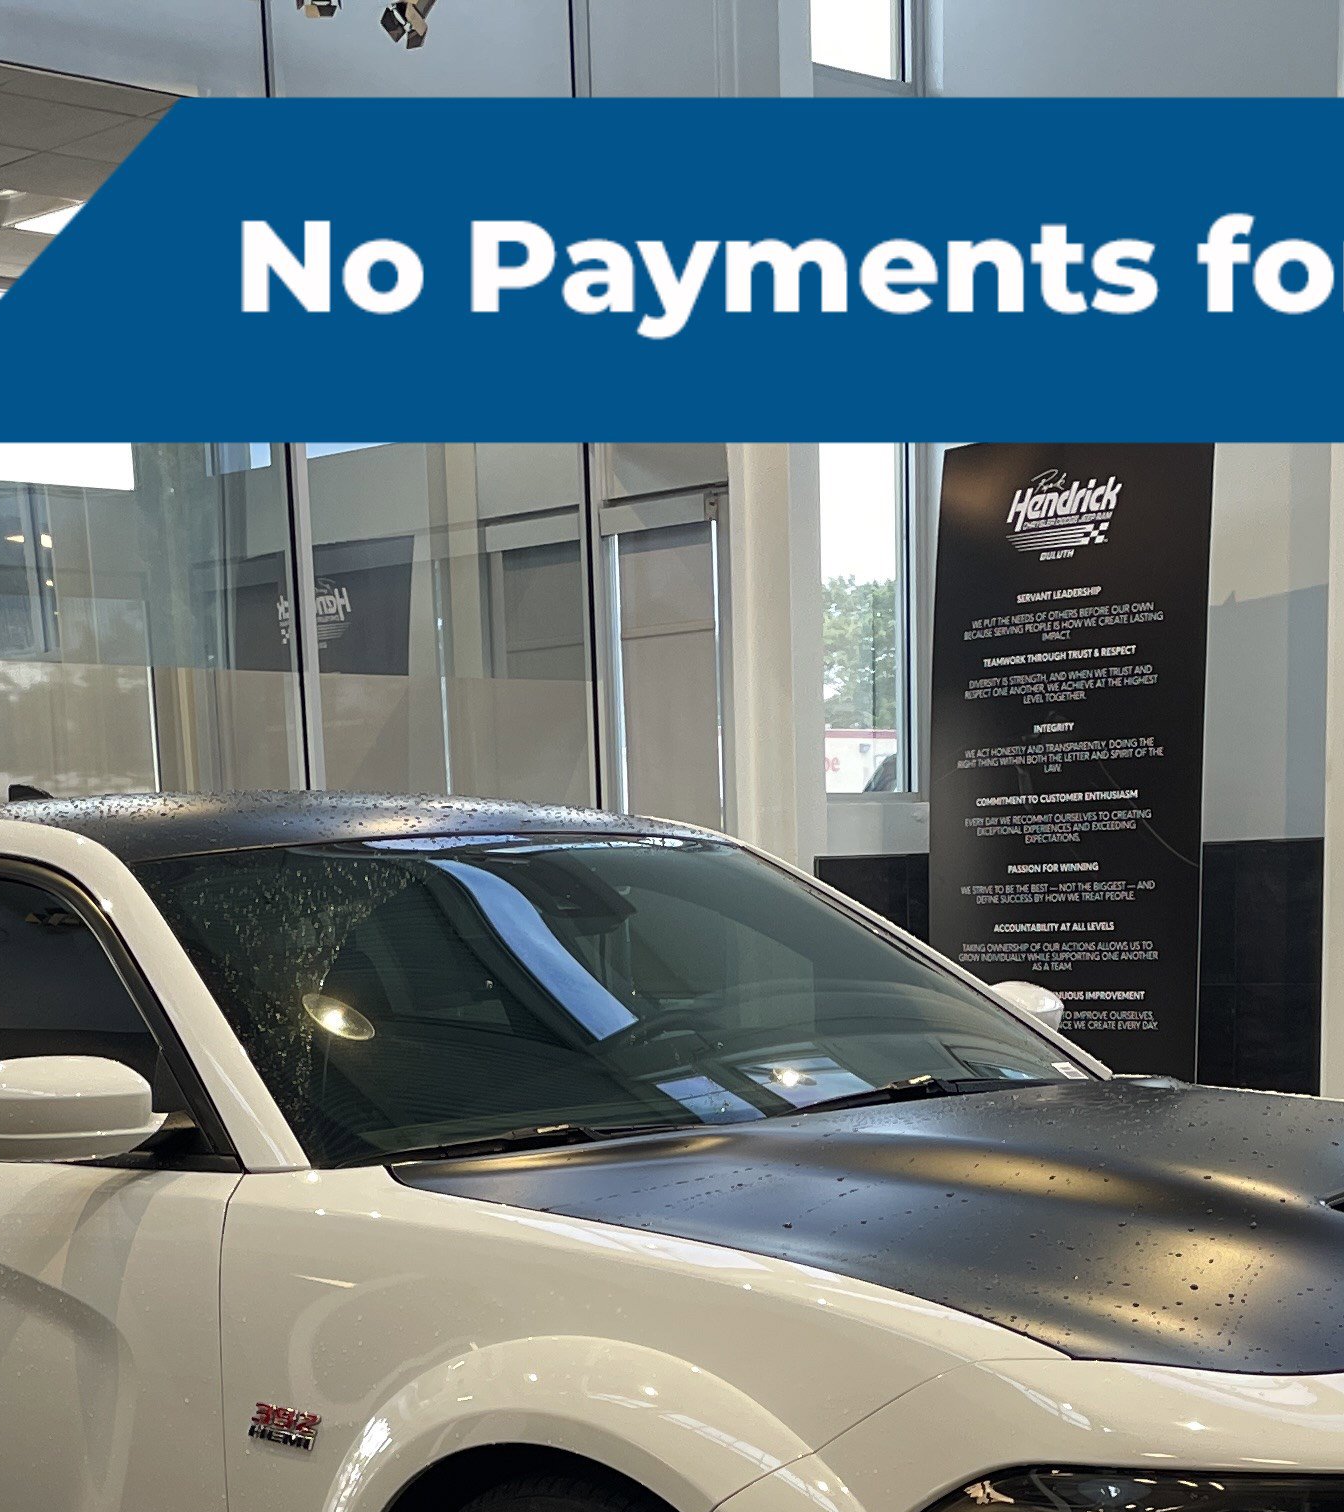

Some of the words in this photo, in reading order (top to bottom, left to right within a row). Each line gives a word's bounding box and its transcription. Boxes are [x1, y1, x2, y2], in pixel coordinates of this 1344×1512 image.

[1006, 475, 1123, 533] Hendrick
[1039, 548, 1075, 561] DULUTH
[1016, 591, 1052, 603] SERVANT
[1052, 585, 1102, 600] LEADERSHIP
[983, 654, 1026, 667] TEAMWORK
[1027, 651, 1067, 663] THROUGH
[1067, 648, 1093, 660] TRUST
[1093, 648, 1100, 658] &
[1101, 645, 1136, 657] RESPECT
[1033, 722, 1075, 733] INTEGRITY
[976, 795, 1027, 806] COMMITMENT
[1027, 794, 1039, 804] TO
[1039, 792, 1083, 803] CUSTOMER
[1084, 789, 1139, 801] ENTHUSIASM
[1008, 864, 1041, 874] PASSION
[1042, 863, 1059, 873] FOR
[1059, 862, 1099, 872] WINNING
[993, 922, 1060, 933] ACCOUNTABILITY
[1060, 922, 1071, 932] AT
[1072, 922, 1086, 932] ALL
[1087, 922, 1115, 931] LEVELS
[1085, 991, 1146, 1000] IMPROVEMENT
[251, 1401, 322, 1434] 392
[248, 1424, 318, 1451] HEMI
